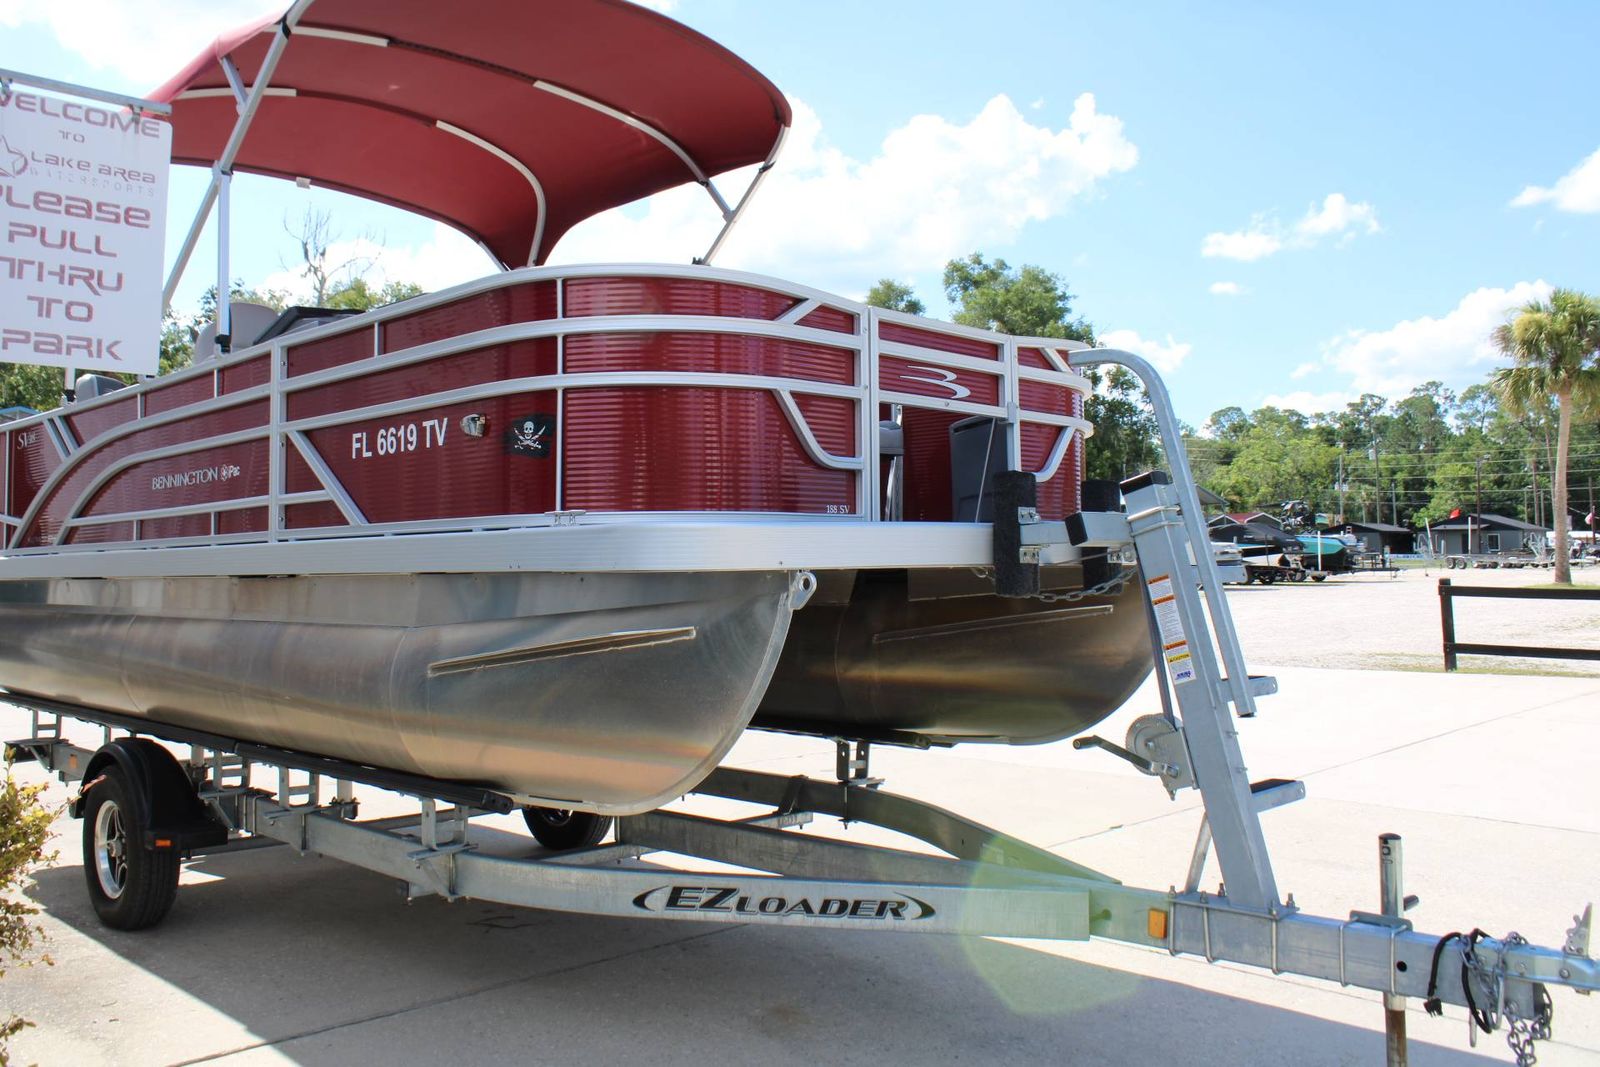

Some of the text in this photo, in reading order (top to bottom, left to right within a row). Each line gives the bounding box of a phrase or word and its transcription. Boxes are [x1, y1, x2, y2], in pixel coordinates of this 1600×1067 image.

[58, 130, 85, 143] TO
[0, 184, 150, 229] Lease
[8, 221, 118, 257] PULL
[0, 256, 123, 296] THRU
[27, 295, 93, 323] TO
[352, 417, 448, 459] FL 6619 TV
[151, 467, 218, 490] BENNINGTON
[826, 505, 850, 514] 188 SV
